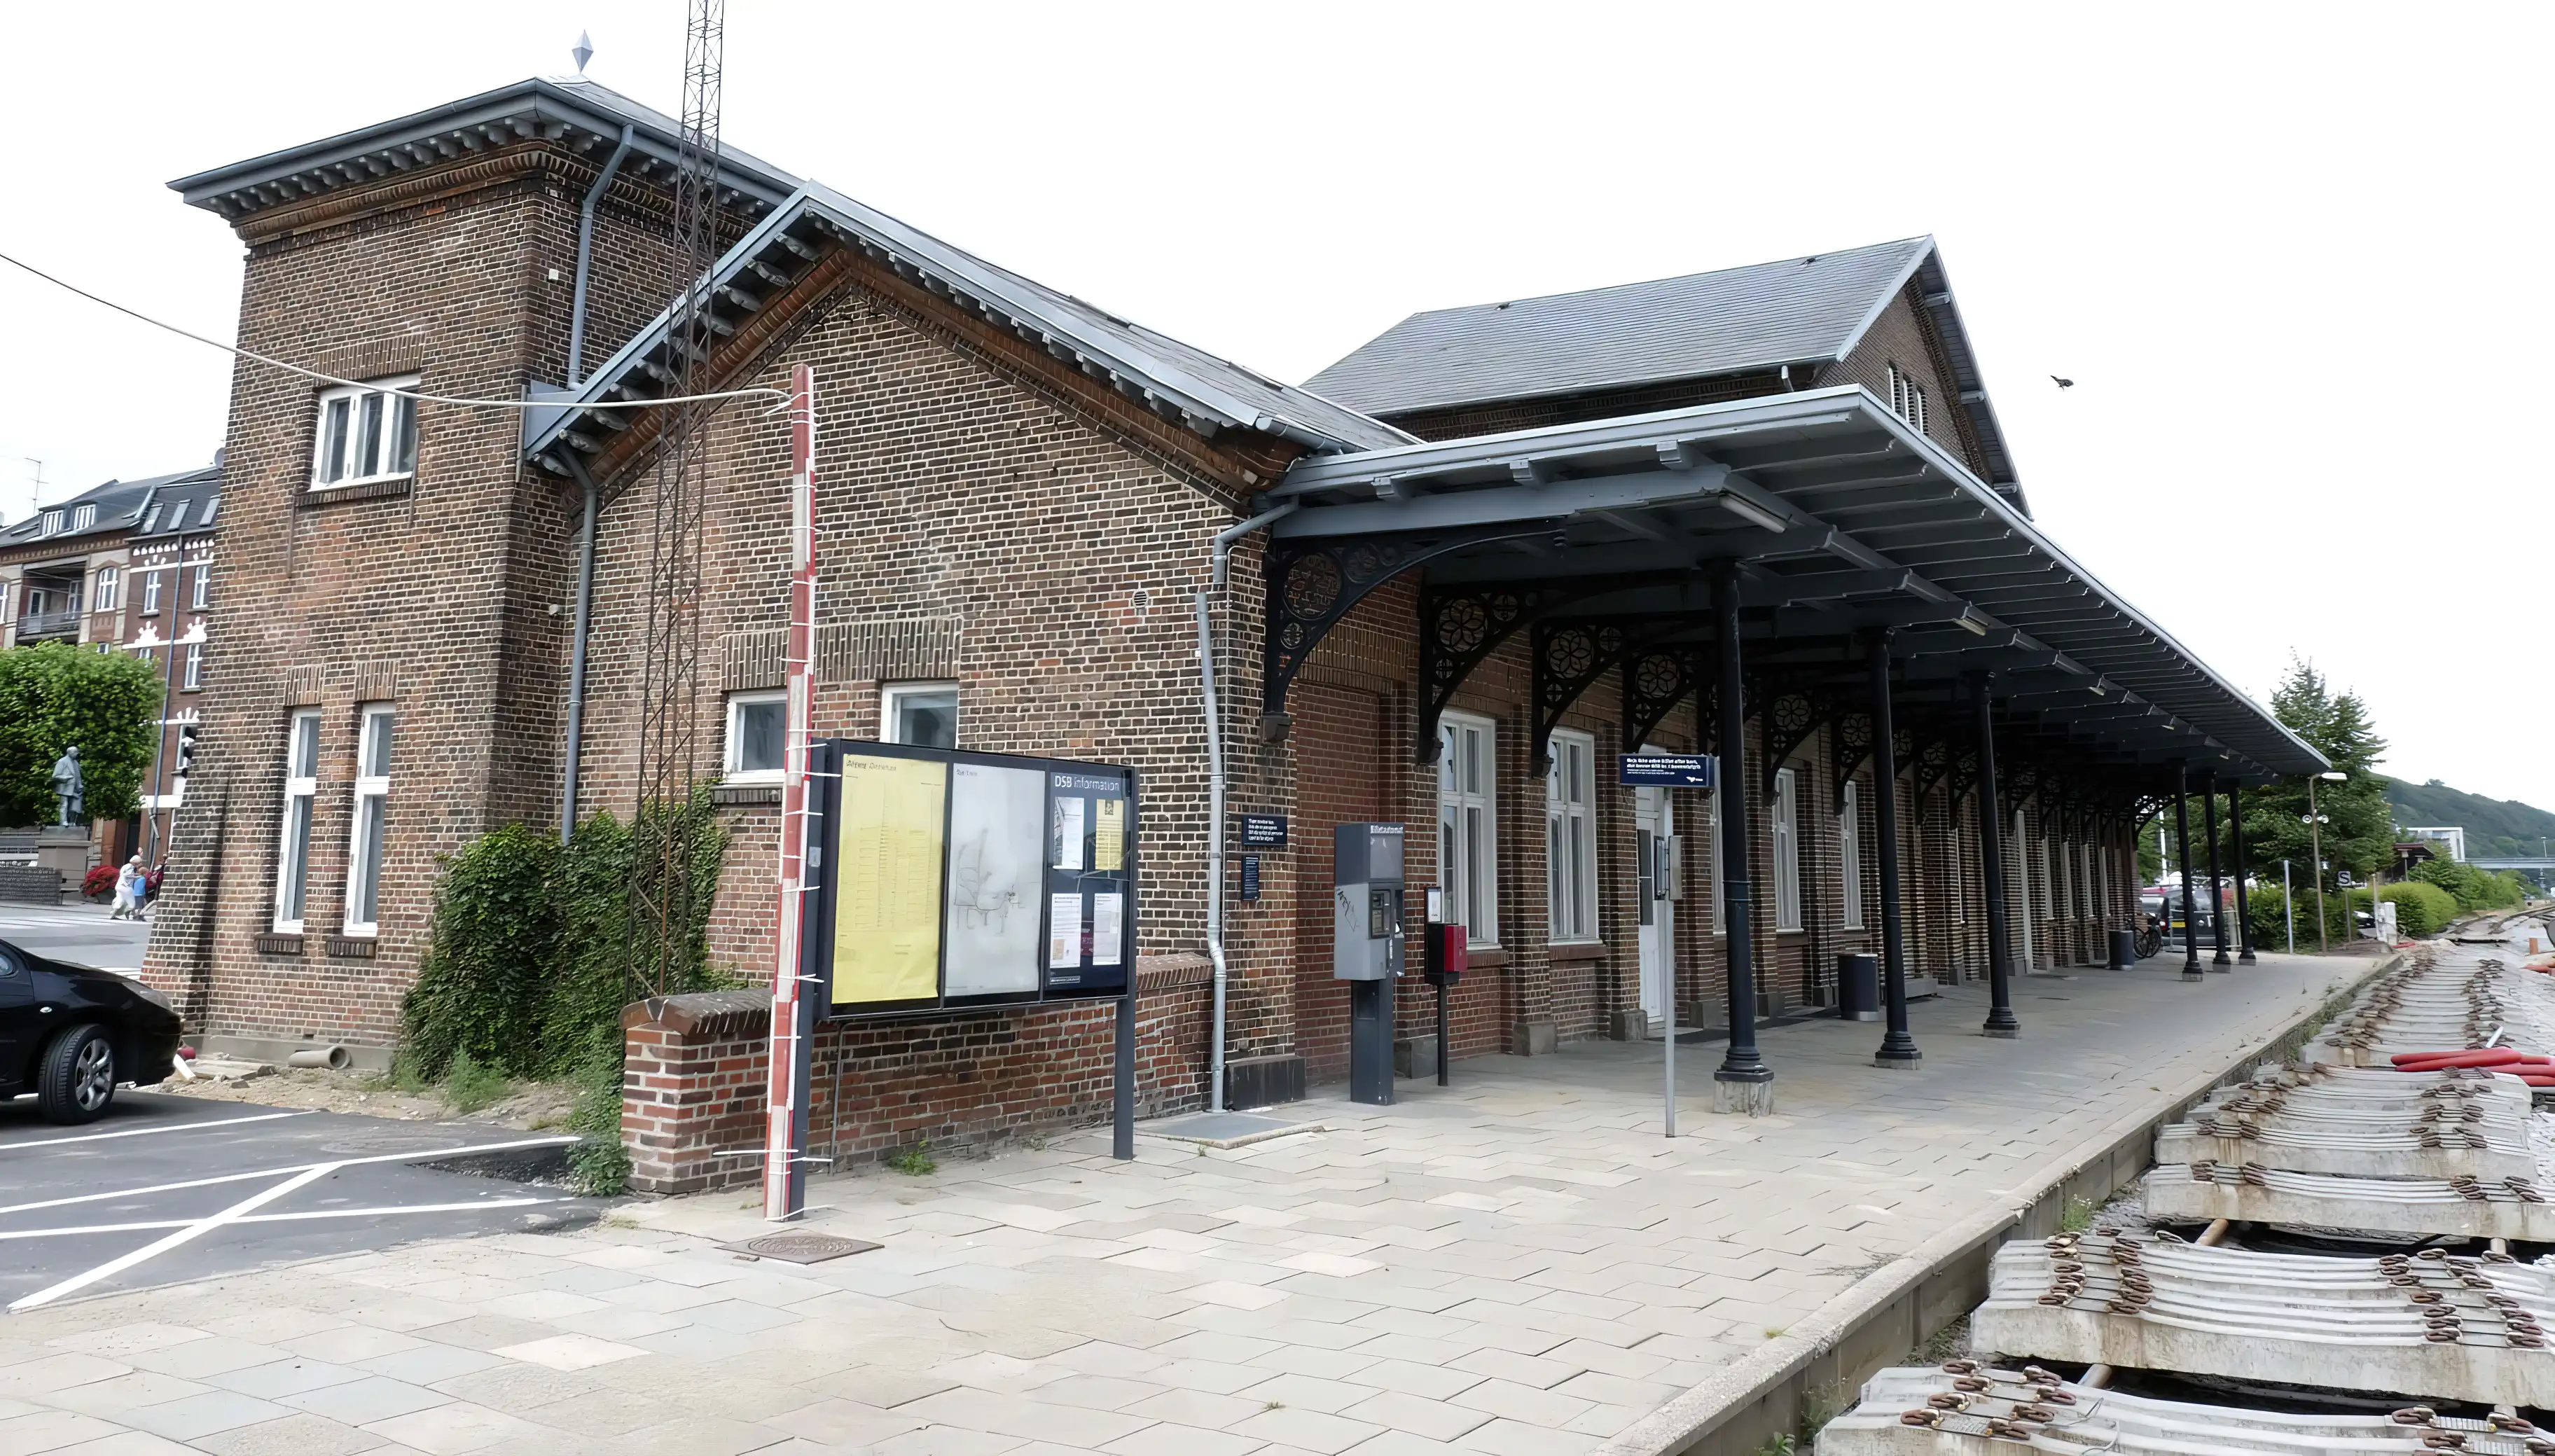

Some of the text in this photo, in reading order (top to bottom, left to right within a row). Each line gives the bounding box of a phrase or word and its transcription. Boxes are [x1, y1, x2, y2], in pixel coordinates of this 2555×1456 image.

[1055, 775, 1120, 791] DSB information
[2340, 872, 2350, 885] S
